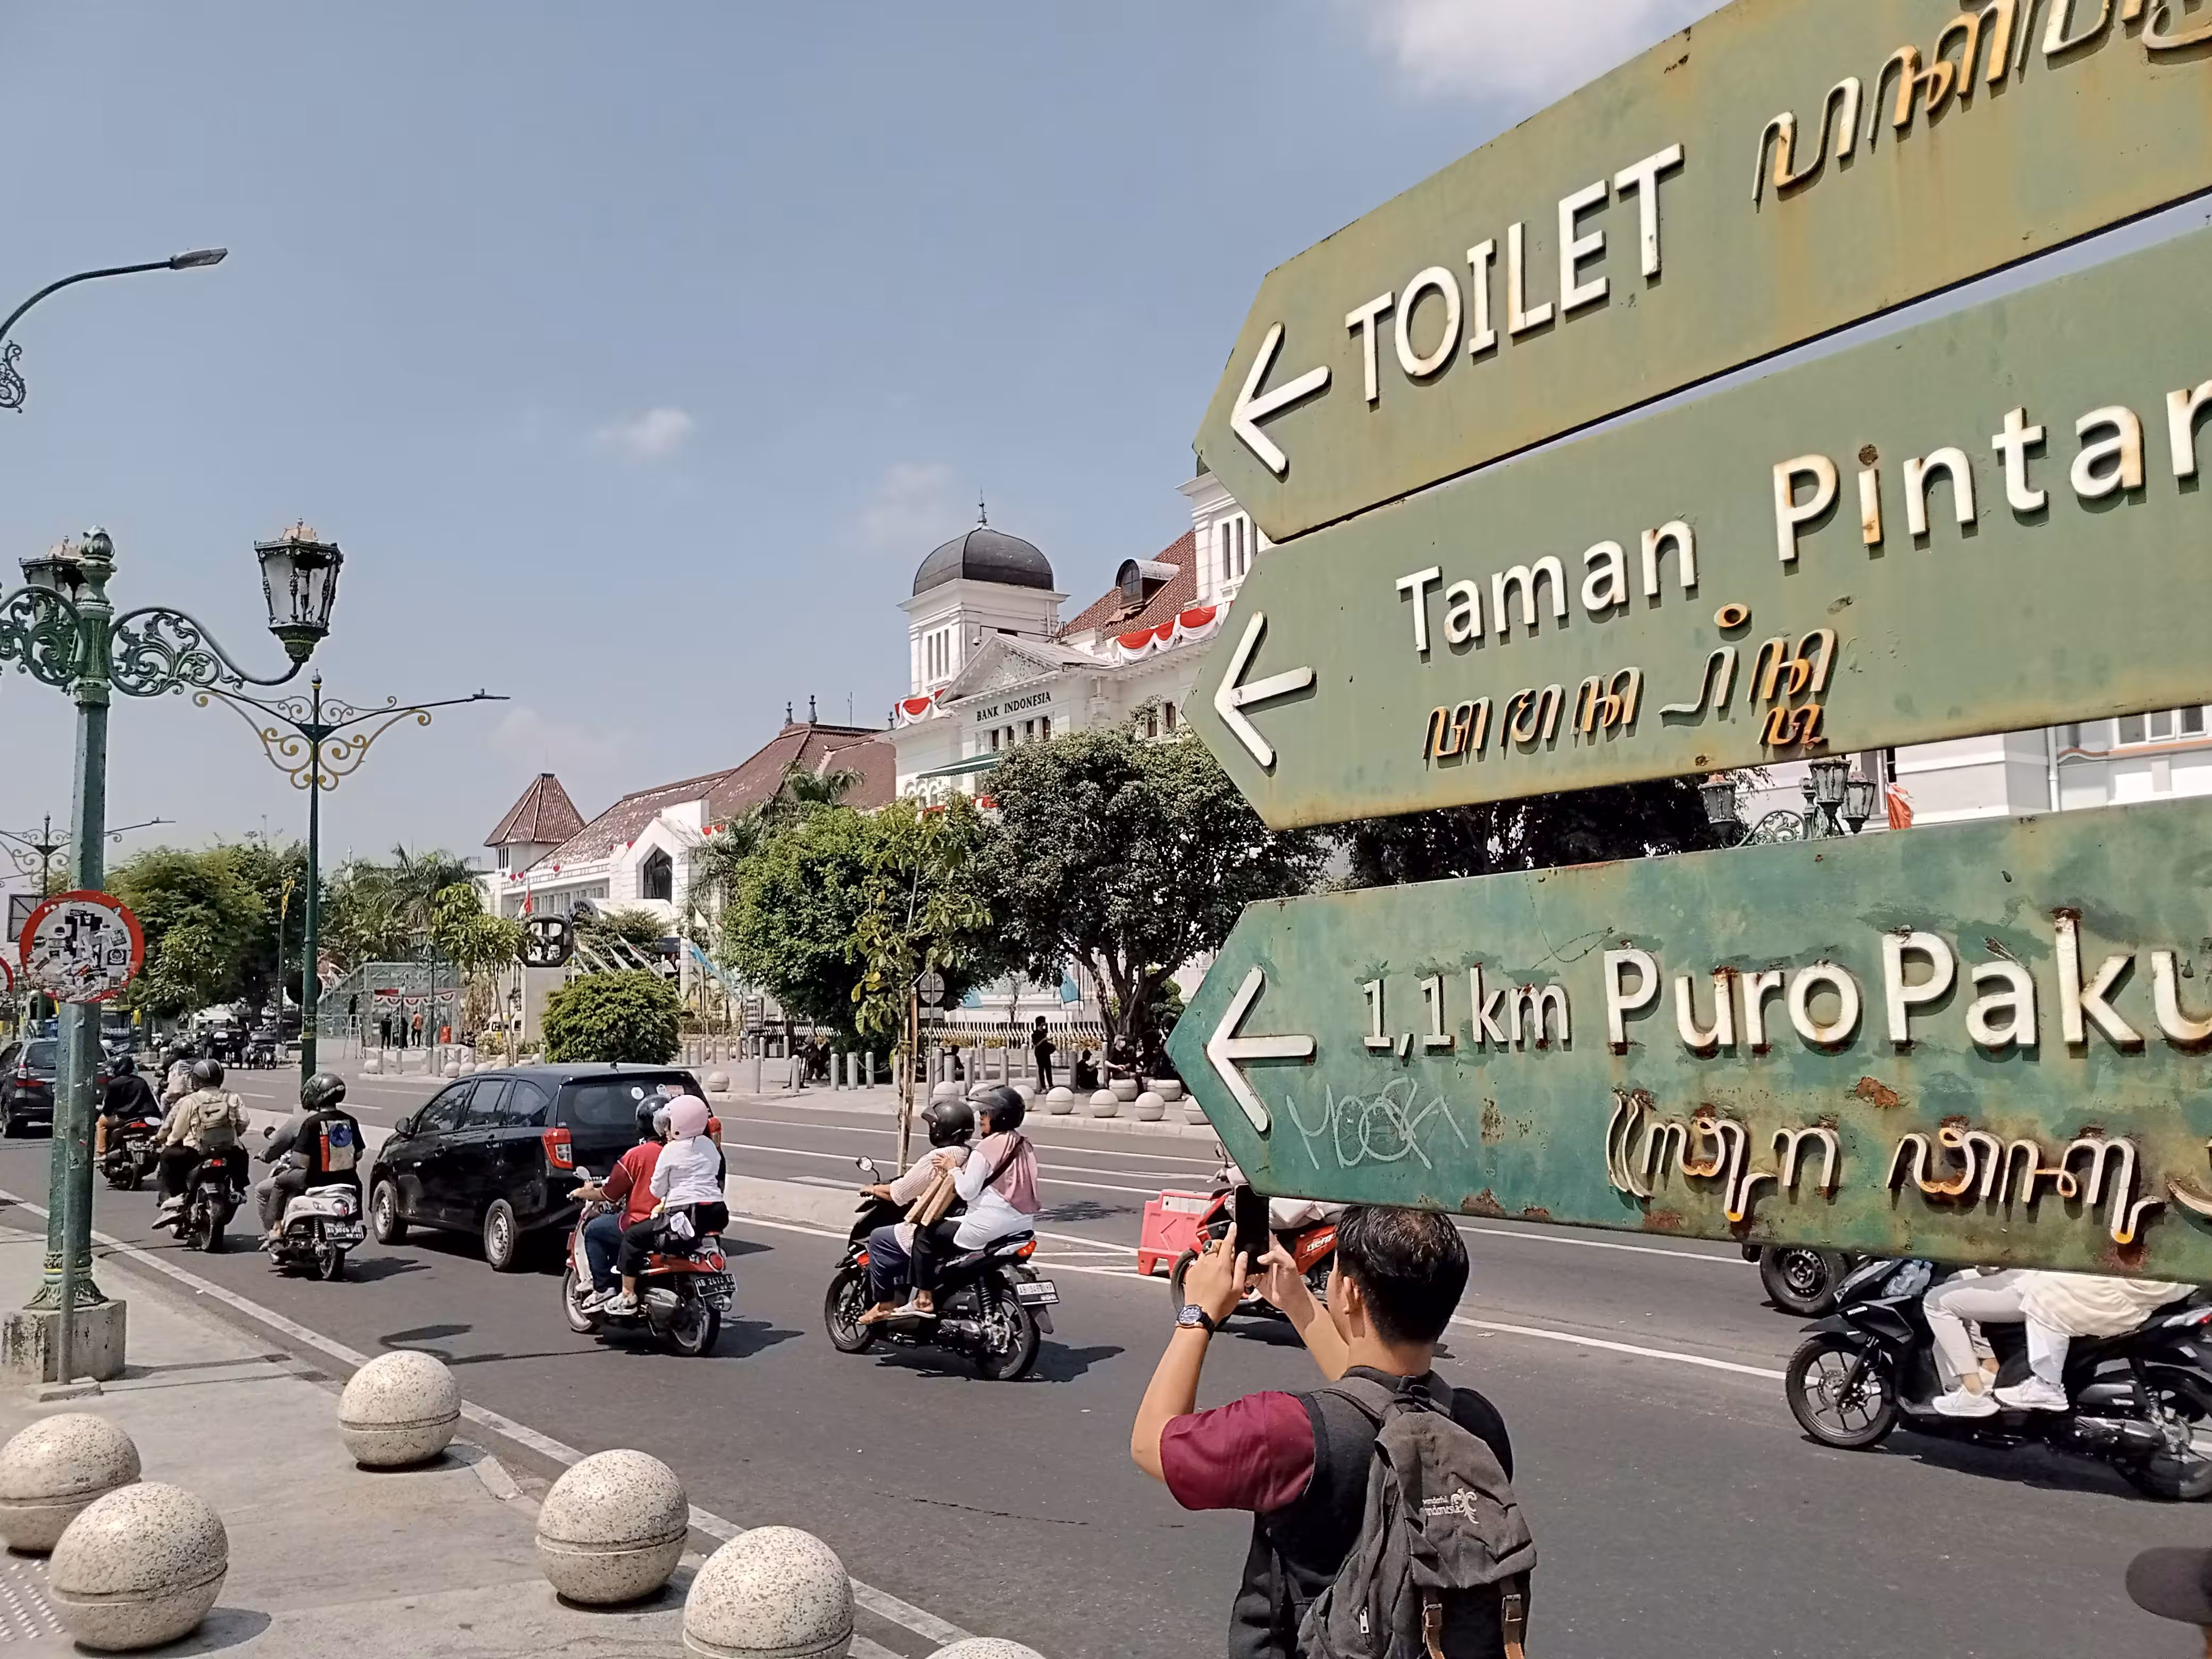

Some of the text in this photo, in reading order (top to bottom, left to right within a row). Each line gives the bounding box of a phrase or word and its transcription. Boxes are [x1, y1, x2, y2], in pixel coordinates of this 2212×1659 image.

[1345, 143, 1685, 404] TOILET
[1395, 520, 1698, 653] Taman
[977, 691, 1052, 722] BANK INDONESIA
[697, 1278, 707, 1287] AB
